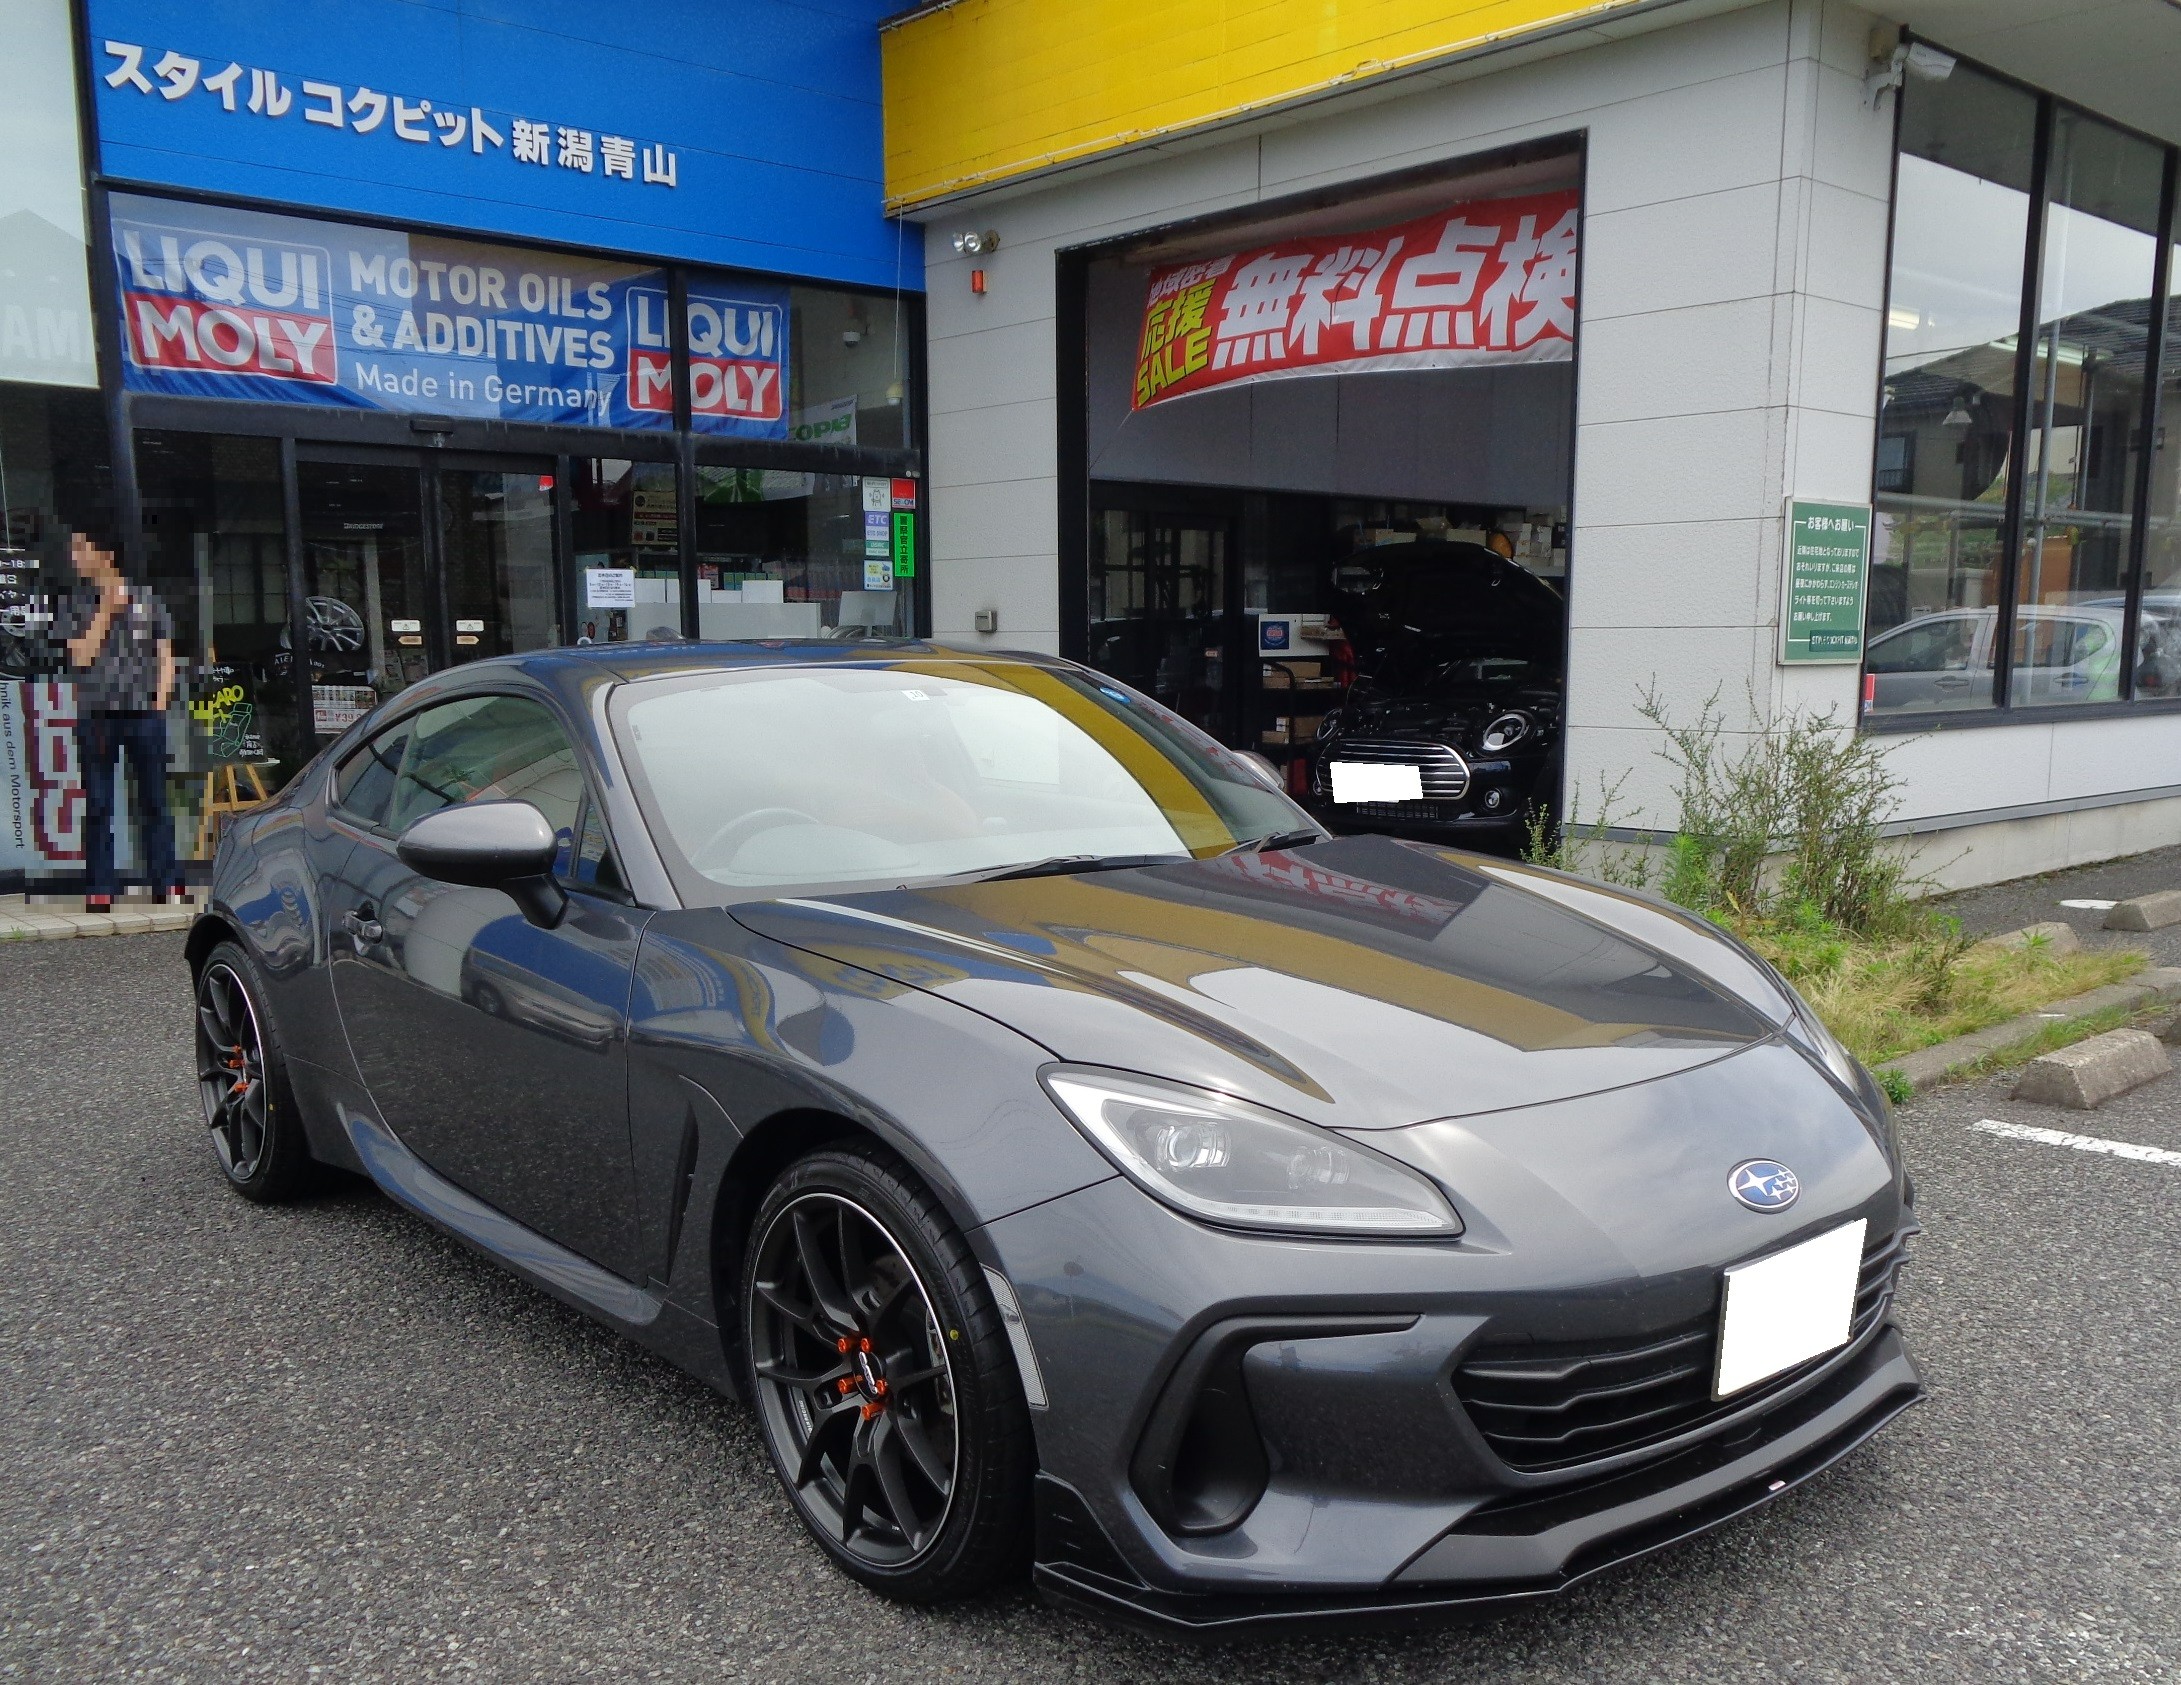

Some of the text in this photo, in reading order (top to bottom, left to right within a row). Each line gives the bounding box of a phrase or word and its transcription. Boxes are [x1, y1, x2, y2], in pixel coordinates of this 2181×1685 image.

[103, 40, 679, 188] スタイル コクピット 新潟青山
[129, 229, 321, 311] LIQUI
[349, 250, 613, 321] MOTOR OILS
[1211, 208, 1579, 371] 無料点検
[136, 299, 332, 379] MOLY
[351, 304, 615, 369] & ADDITIVES
[1140, 281, 1214, 361] 応援
[356, 361, 612, 419] Made in Germany
[1137, 326, 1212, 408] SALE
[868, 514, 887, 524] ETC
[1807, 515, 1855, 532] お客様へお願い
[2, 712, 12, 738] aus
[6, 740, 16, 770] dem
[10, 774, 25, 849] Motorsport
